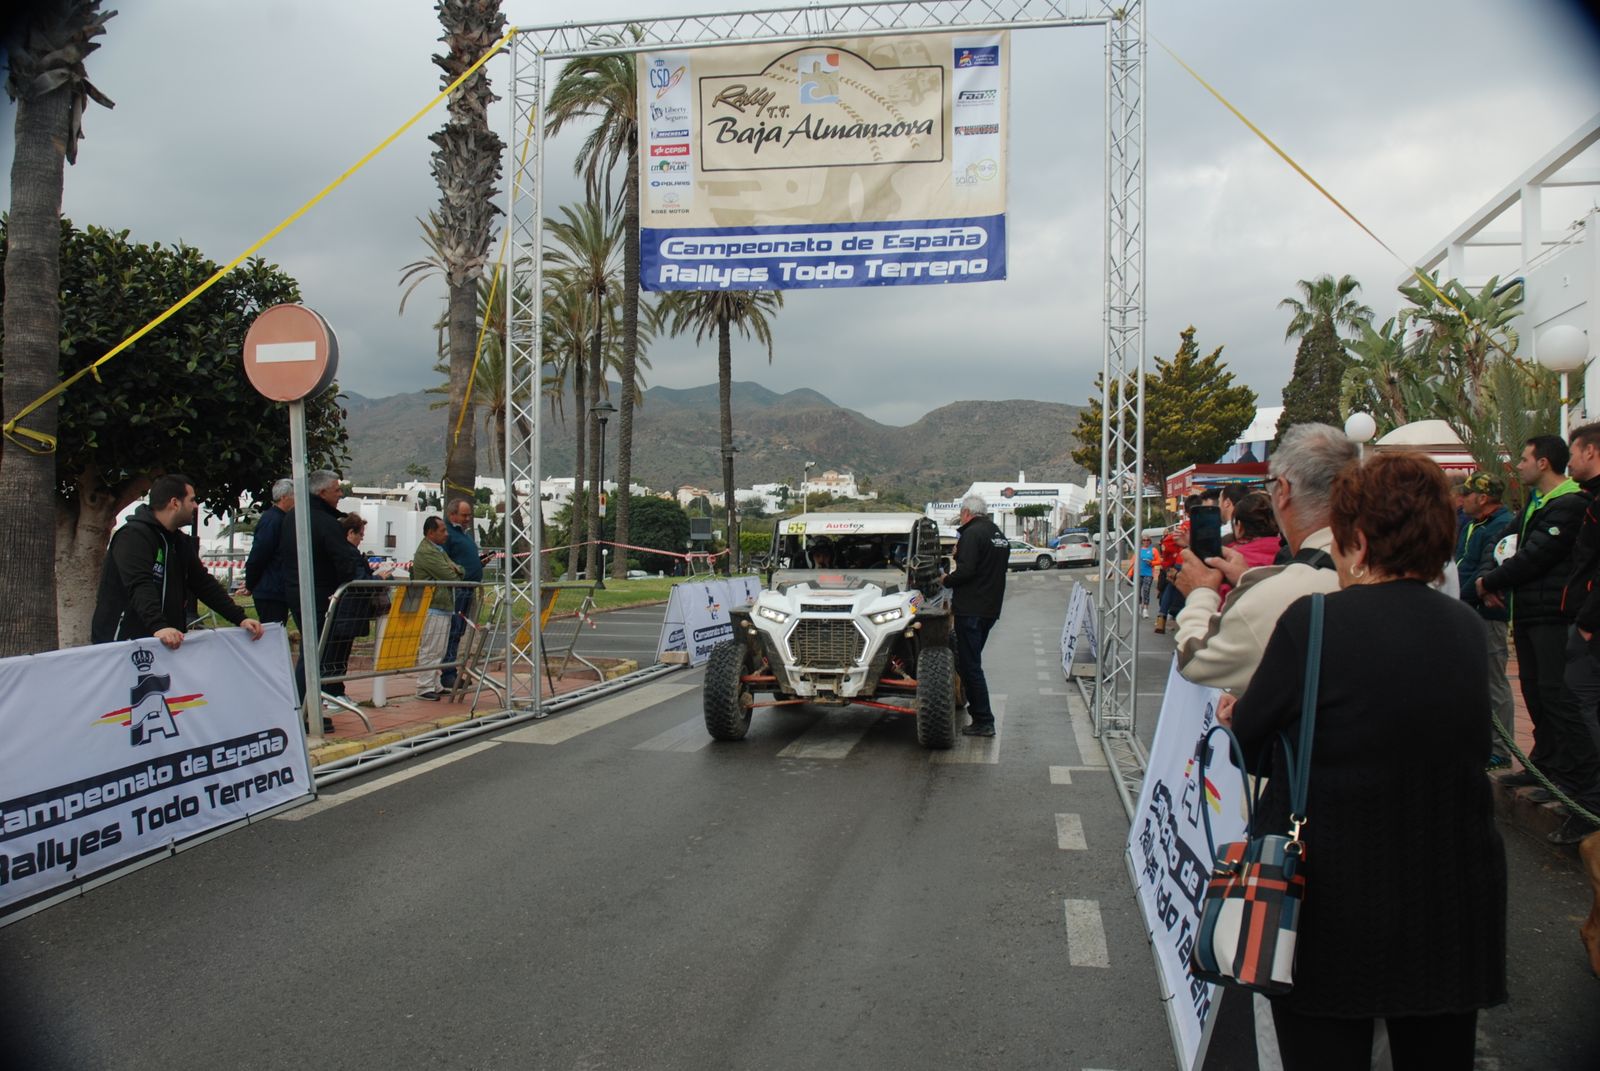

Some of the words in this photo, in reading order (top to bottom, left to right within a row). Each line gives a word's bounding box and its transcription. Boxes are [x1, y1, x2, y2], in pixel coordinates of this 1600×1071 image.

[650, 68, 670, 88] CSD
[712, 84, 775, 117] Rally
[767, 105, 790, 118] T.T.
[707, 116, 783, 154] Baja
[782, 113, 934, 149] Almanzora
[667, 237, 834, 257] Campeonato
[841, 236, 874, 250] de
[883, 229, 981, 251] España
[659, 263, 769, 288] Rallyes
[779, 261, 855, 281] Todo
[864, 257, 988, 278] Terreno
[0, 765, 174, 835] ampeonato
[180, 753, 208, 778] de
[212, 732, 284, 770] España
[132, 795, 199, 835] Todo
[204, 766, 295, 809] Terreno
